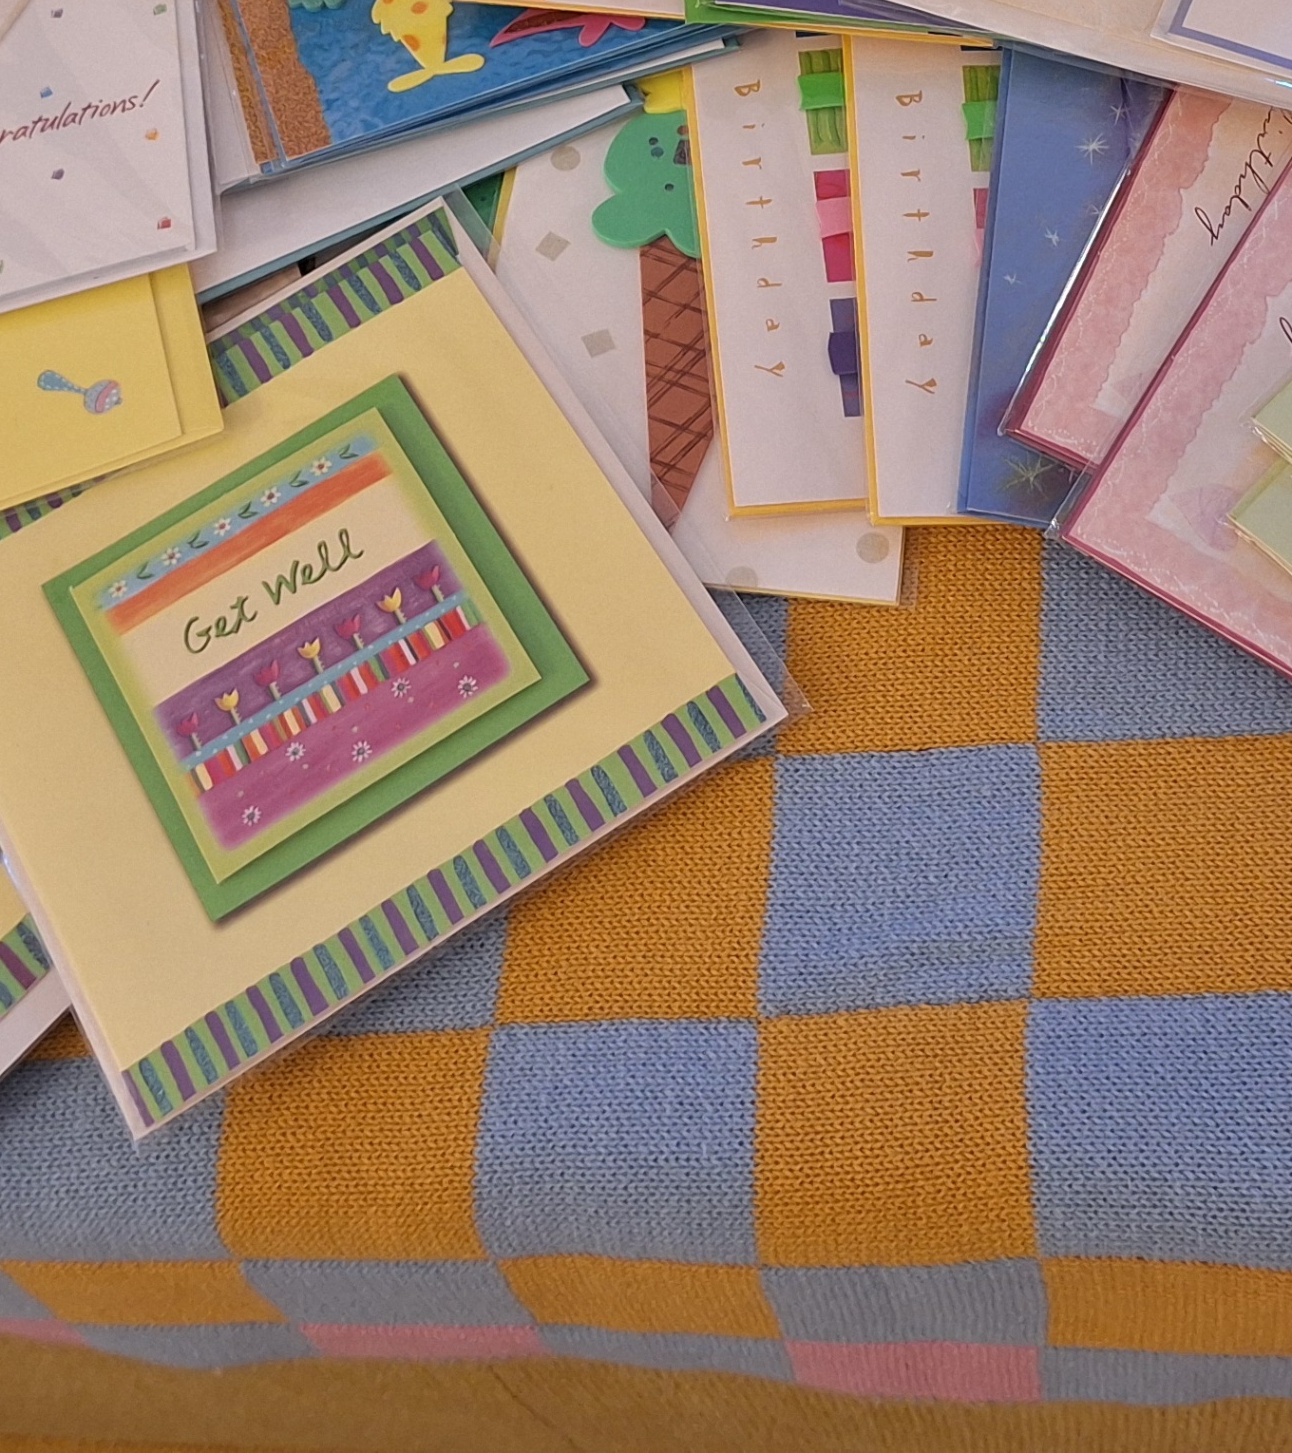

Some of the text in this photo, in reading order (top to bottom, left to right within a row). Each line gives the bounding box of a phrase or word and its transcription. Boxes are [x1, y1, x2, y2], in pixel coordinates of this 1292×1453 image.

[734, 79, 786, 378] Birthday
[895, 90, 938, 394] Birthday
[183, 528, 365, 654] Get Well
